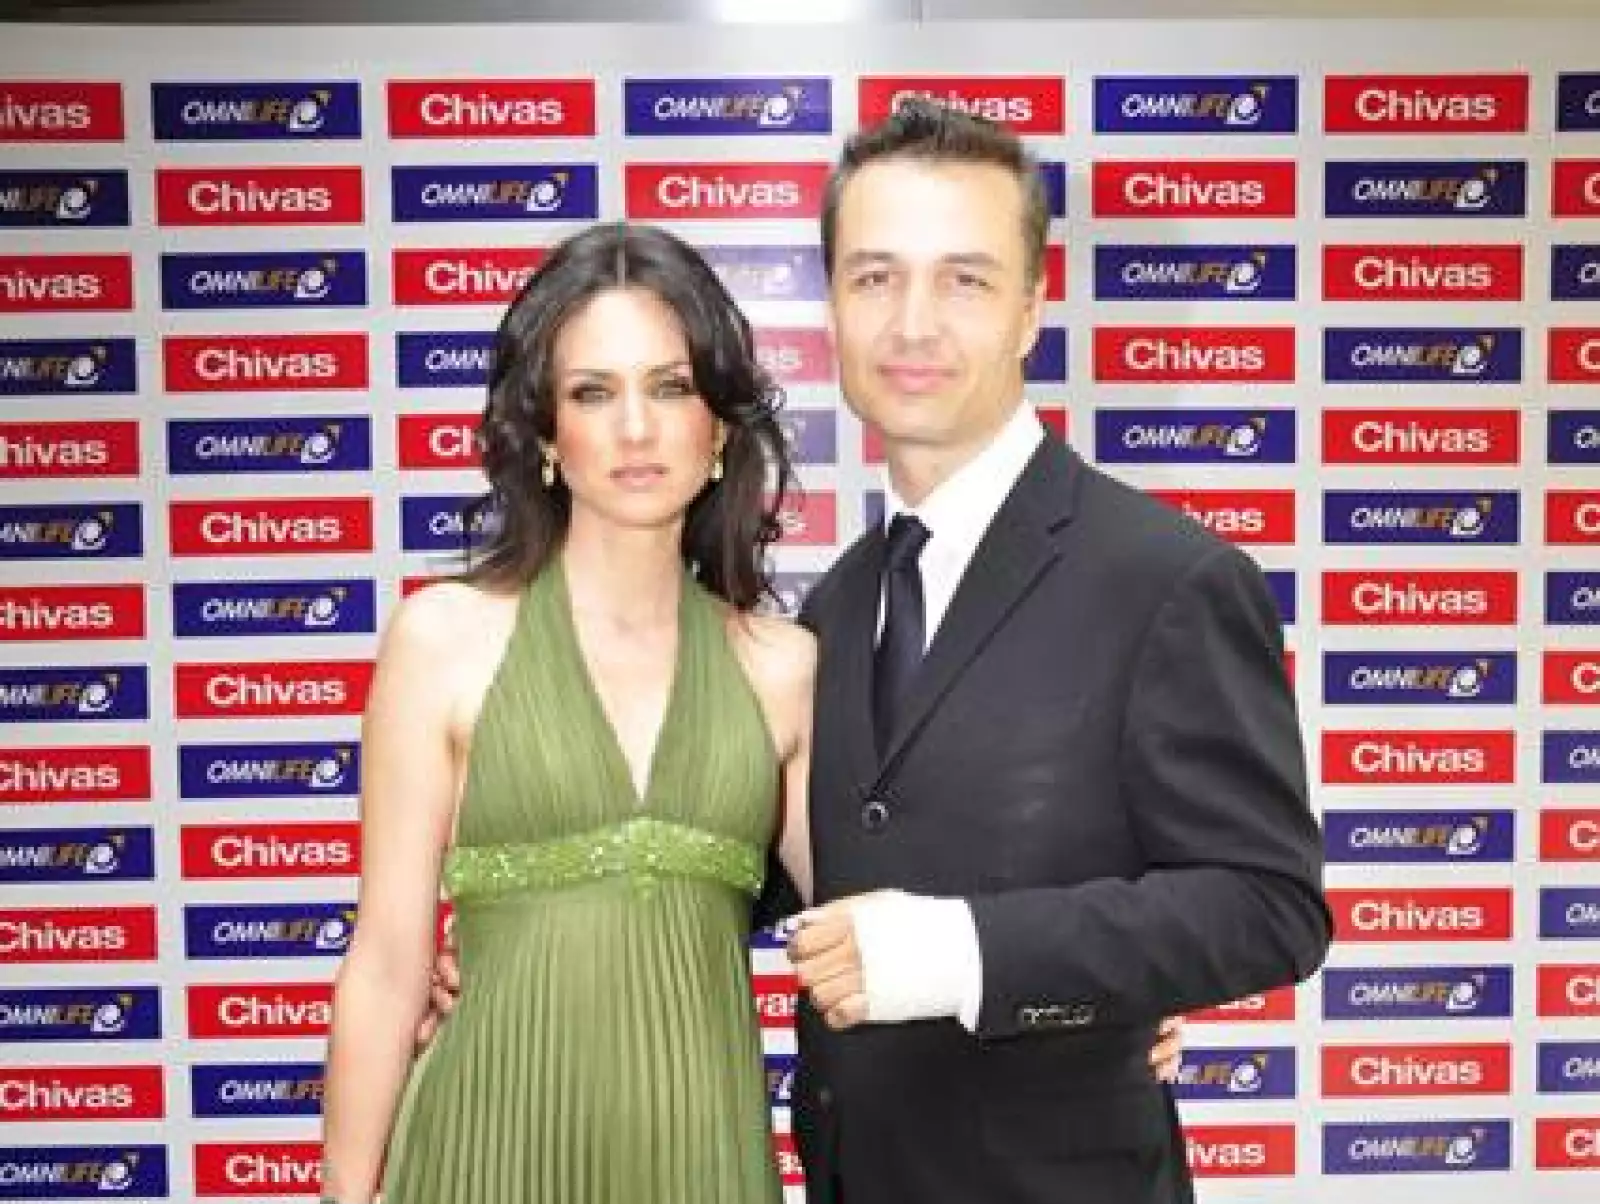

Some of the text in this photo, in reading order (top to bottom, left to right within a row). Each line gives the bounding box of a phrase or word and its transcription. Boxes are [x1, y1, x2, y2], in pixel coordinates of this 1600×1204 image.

[0, 94, 91, 129] ivas
[421, 94, 562, 125] Chivas
[1355, 90, 1495, 121] Chivas
[188, 181, 332, 213] Chivas
[658, 176, 800, 207] Chivas
[1124, 173, 1264, 205] Chivas
[1353, 256, 1492, 287] Chivas
[195, 349, 338, 380] Chivas
[1125, 339, 1265, 370] Chivas
[0, 436, 109, 465] hivas
[1353, 421, 1489, 453] Chivas
[202, 512, 341, 543] Chivas
[1352, 582, 1488, 614] Chivas
[0, 598, 114, 630] hivas
[206, 675, 346, 706] Chivas
[1350, 741, 1484, 772] Chivas
[211, 835, 351, 867] Chivas
[1350, 900, 1484, 930] Chivas
[218, 995, 331, 1026] Chiva
[1350, 1056, 1481, 1086] Chivas
[0, 1079, 133, 1110] Chivas
[1186, 1136, 1266, 1168] ivas
